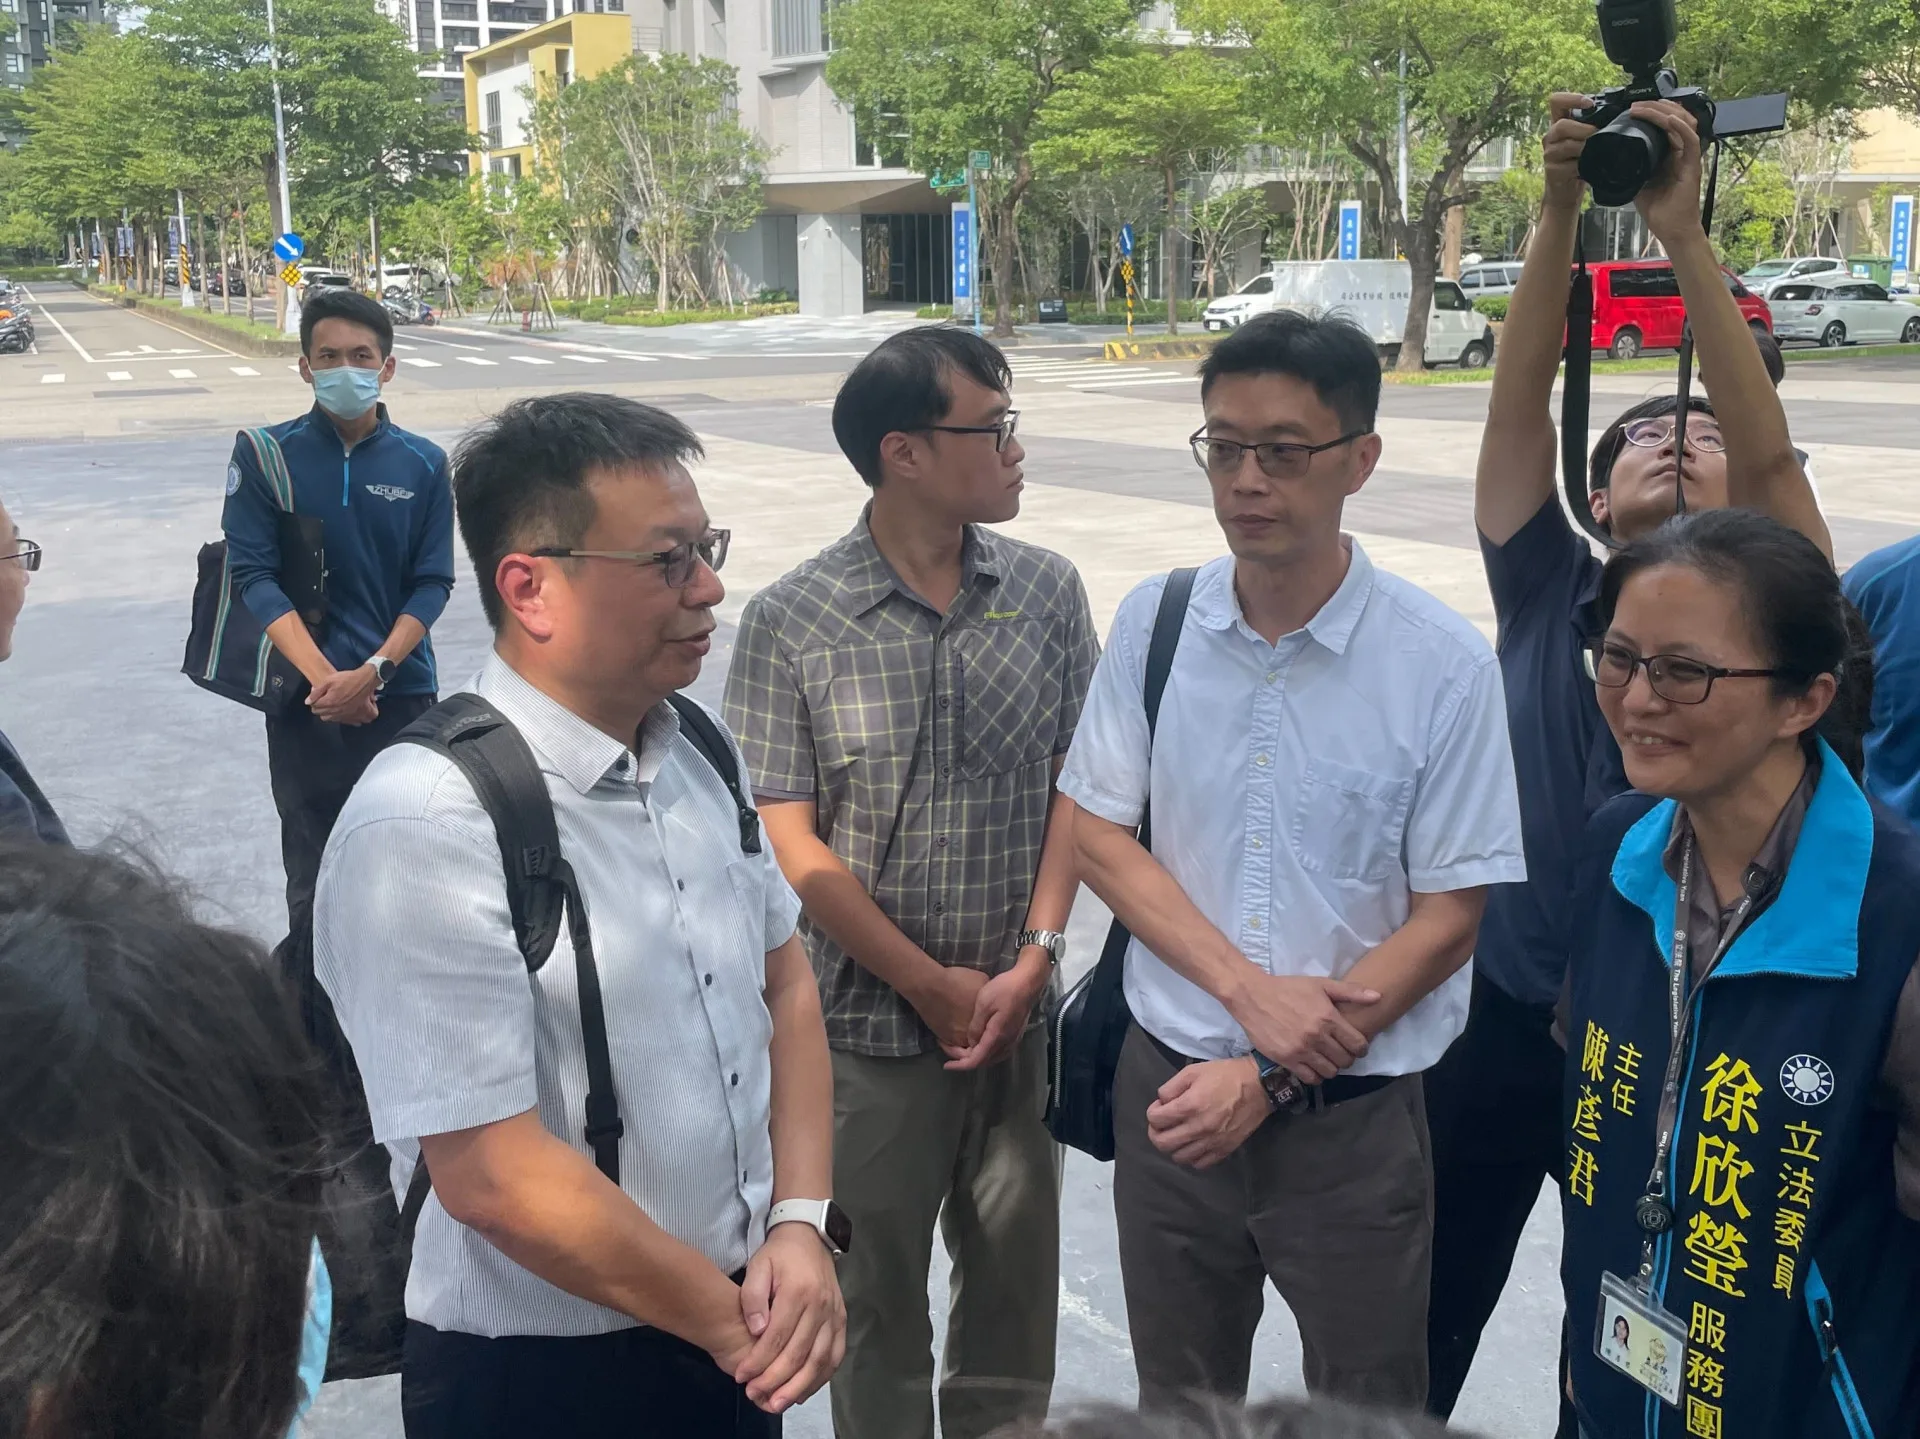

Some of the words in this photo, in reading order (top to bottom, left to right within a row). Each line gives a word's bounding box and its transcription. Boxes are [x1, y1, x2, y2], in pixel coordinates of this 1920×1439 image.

[1629, 87, 1653, 95] SONY
[1672, 982, 1680, 1020] Legislative
[1673, 969, 1681, 981] The
[1568, 1020, 1610, 1206] 陳彥君
[1612, 1042, 1642, 1116] 主任
[1684, 1052, 1763, 1298] 徐欣瑩
[1772, 1120, 1823, 1300] 立法委員
[1686, 1301, 1727, 1439] 服務團
